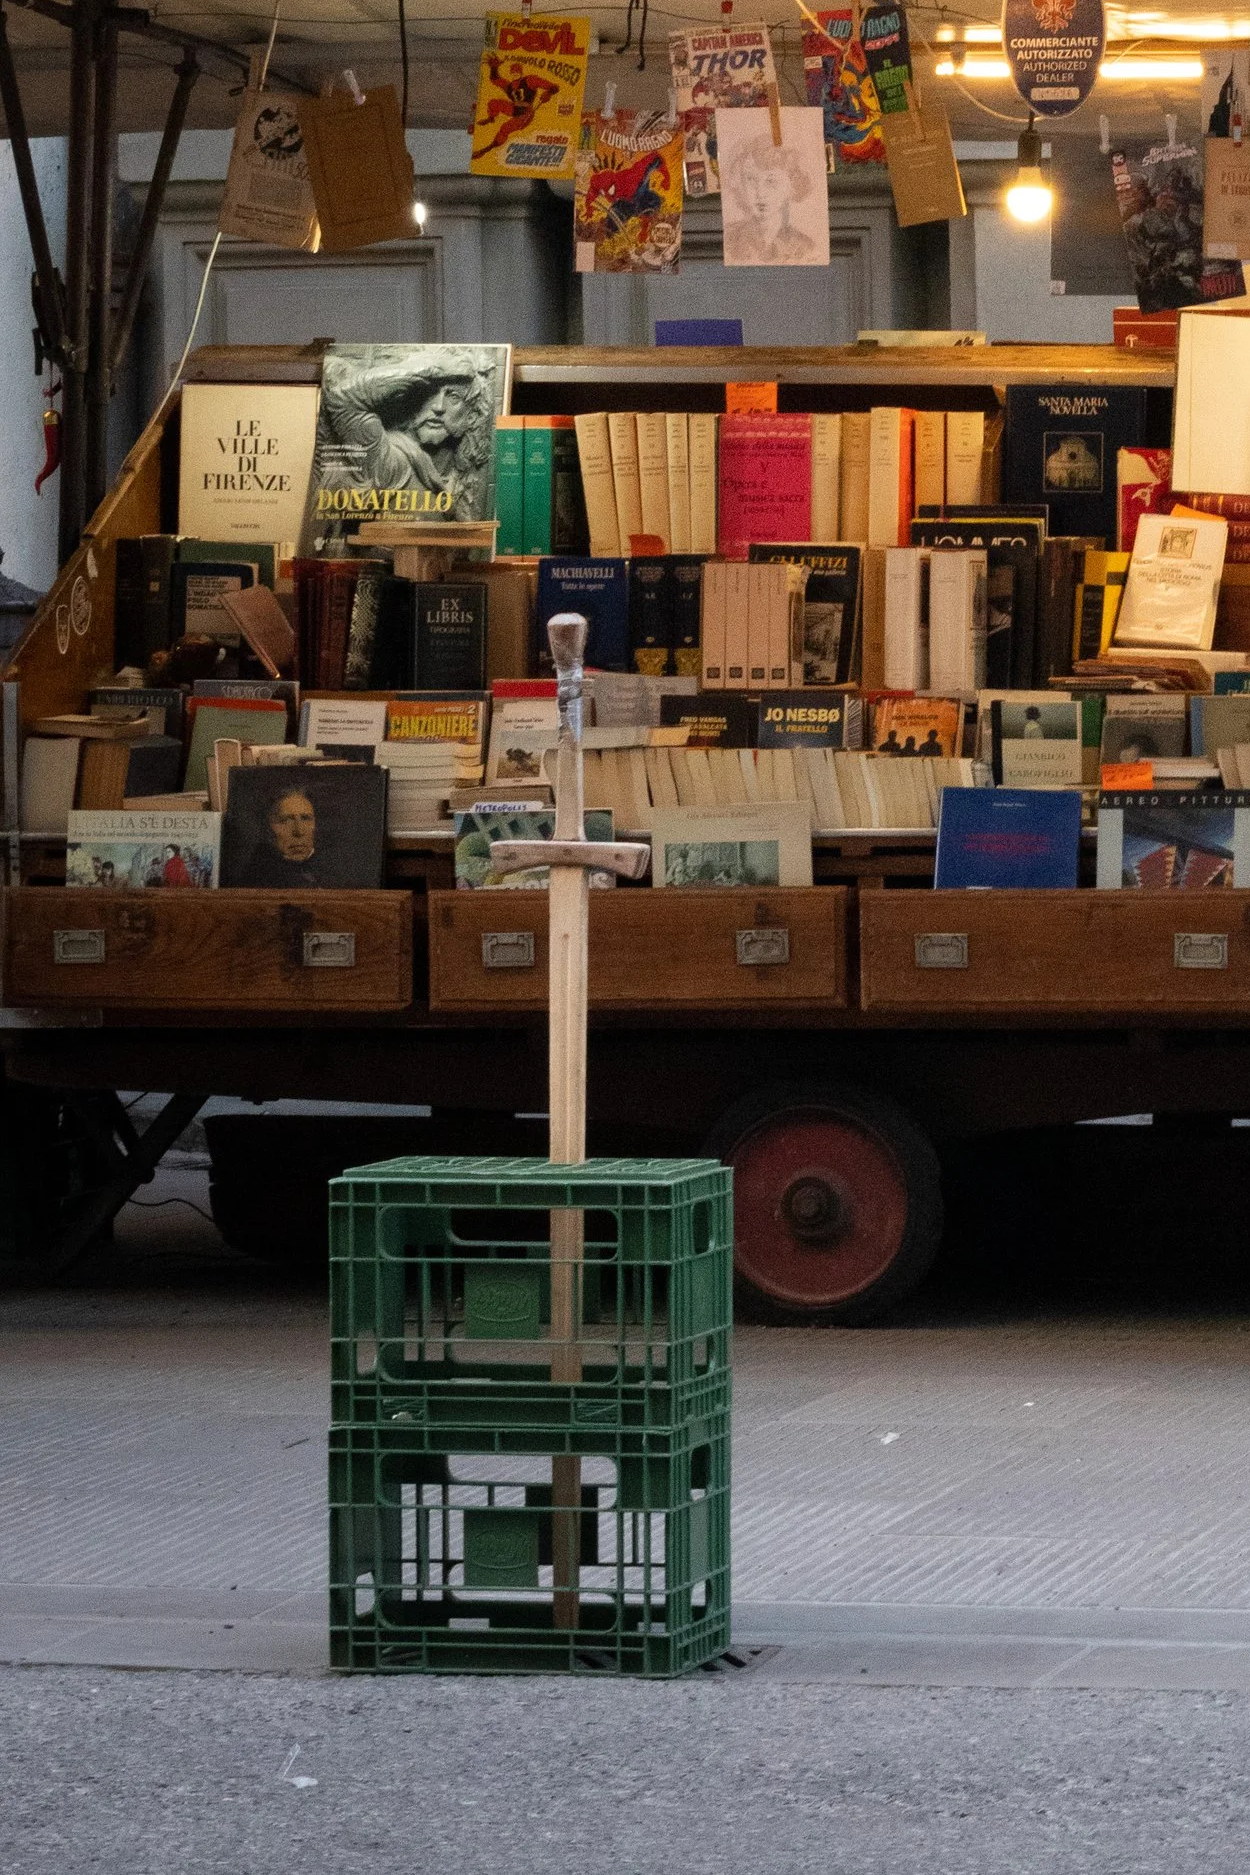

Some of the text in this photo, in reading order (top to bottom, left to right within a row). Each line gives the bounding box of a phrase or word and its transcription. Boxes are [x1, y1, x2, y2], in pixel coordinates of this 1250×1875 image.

[1010, 36, 1099, 49] COMMERCIANTE
[1016, 48, 1093, 61] AUTORIZZATO
[691, 48, 768, 76] THOR
[1023, 60, 1088, 73] AUTHORIZED
[547, 59, 582, 88] ROSSO
[1035, 72, 1075, 83] DEALER
[1038, 396, 1110, 408] SANTA MARIA
[1049, 405, 1099, 416] NOVELLA
[236, 420, 261, 437] LE
[217, 437, 279, 455] VILLE
[238, 456, 257, 473] DI
[203, 472, 291, 492] FIRENZE
[317, 488, 453, 513] DONATELLO
[342, 511, 375, 520] Lorenzo
[552, 567, 615, 579] MACHIAVELLI
[441, 598, 460, 611] EX
[426, 611, 474, 624] LIBRIS
[466, 705, 476, 714] 2
[764, 707, 841, 723] JO NESBØ
[388, 715, 477, 736] CANZONIERE
[1101, 797, 1159, 805] AEREO
[474, 804, 527, 812] METROPOLIS
[162, 816, 209, 830] DESTA
